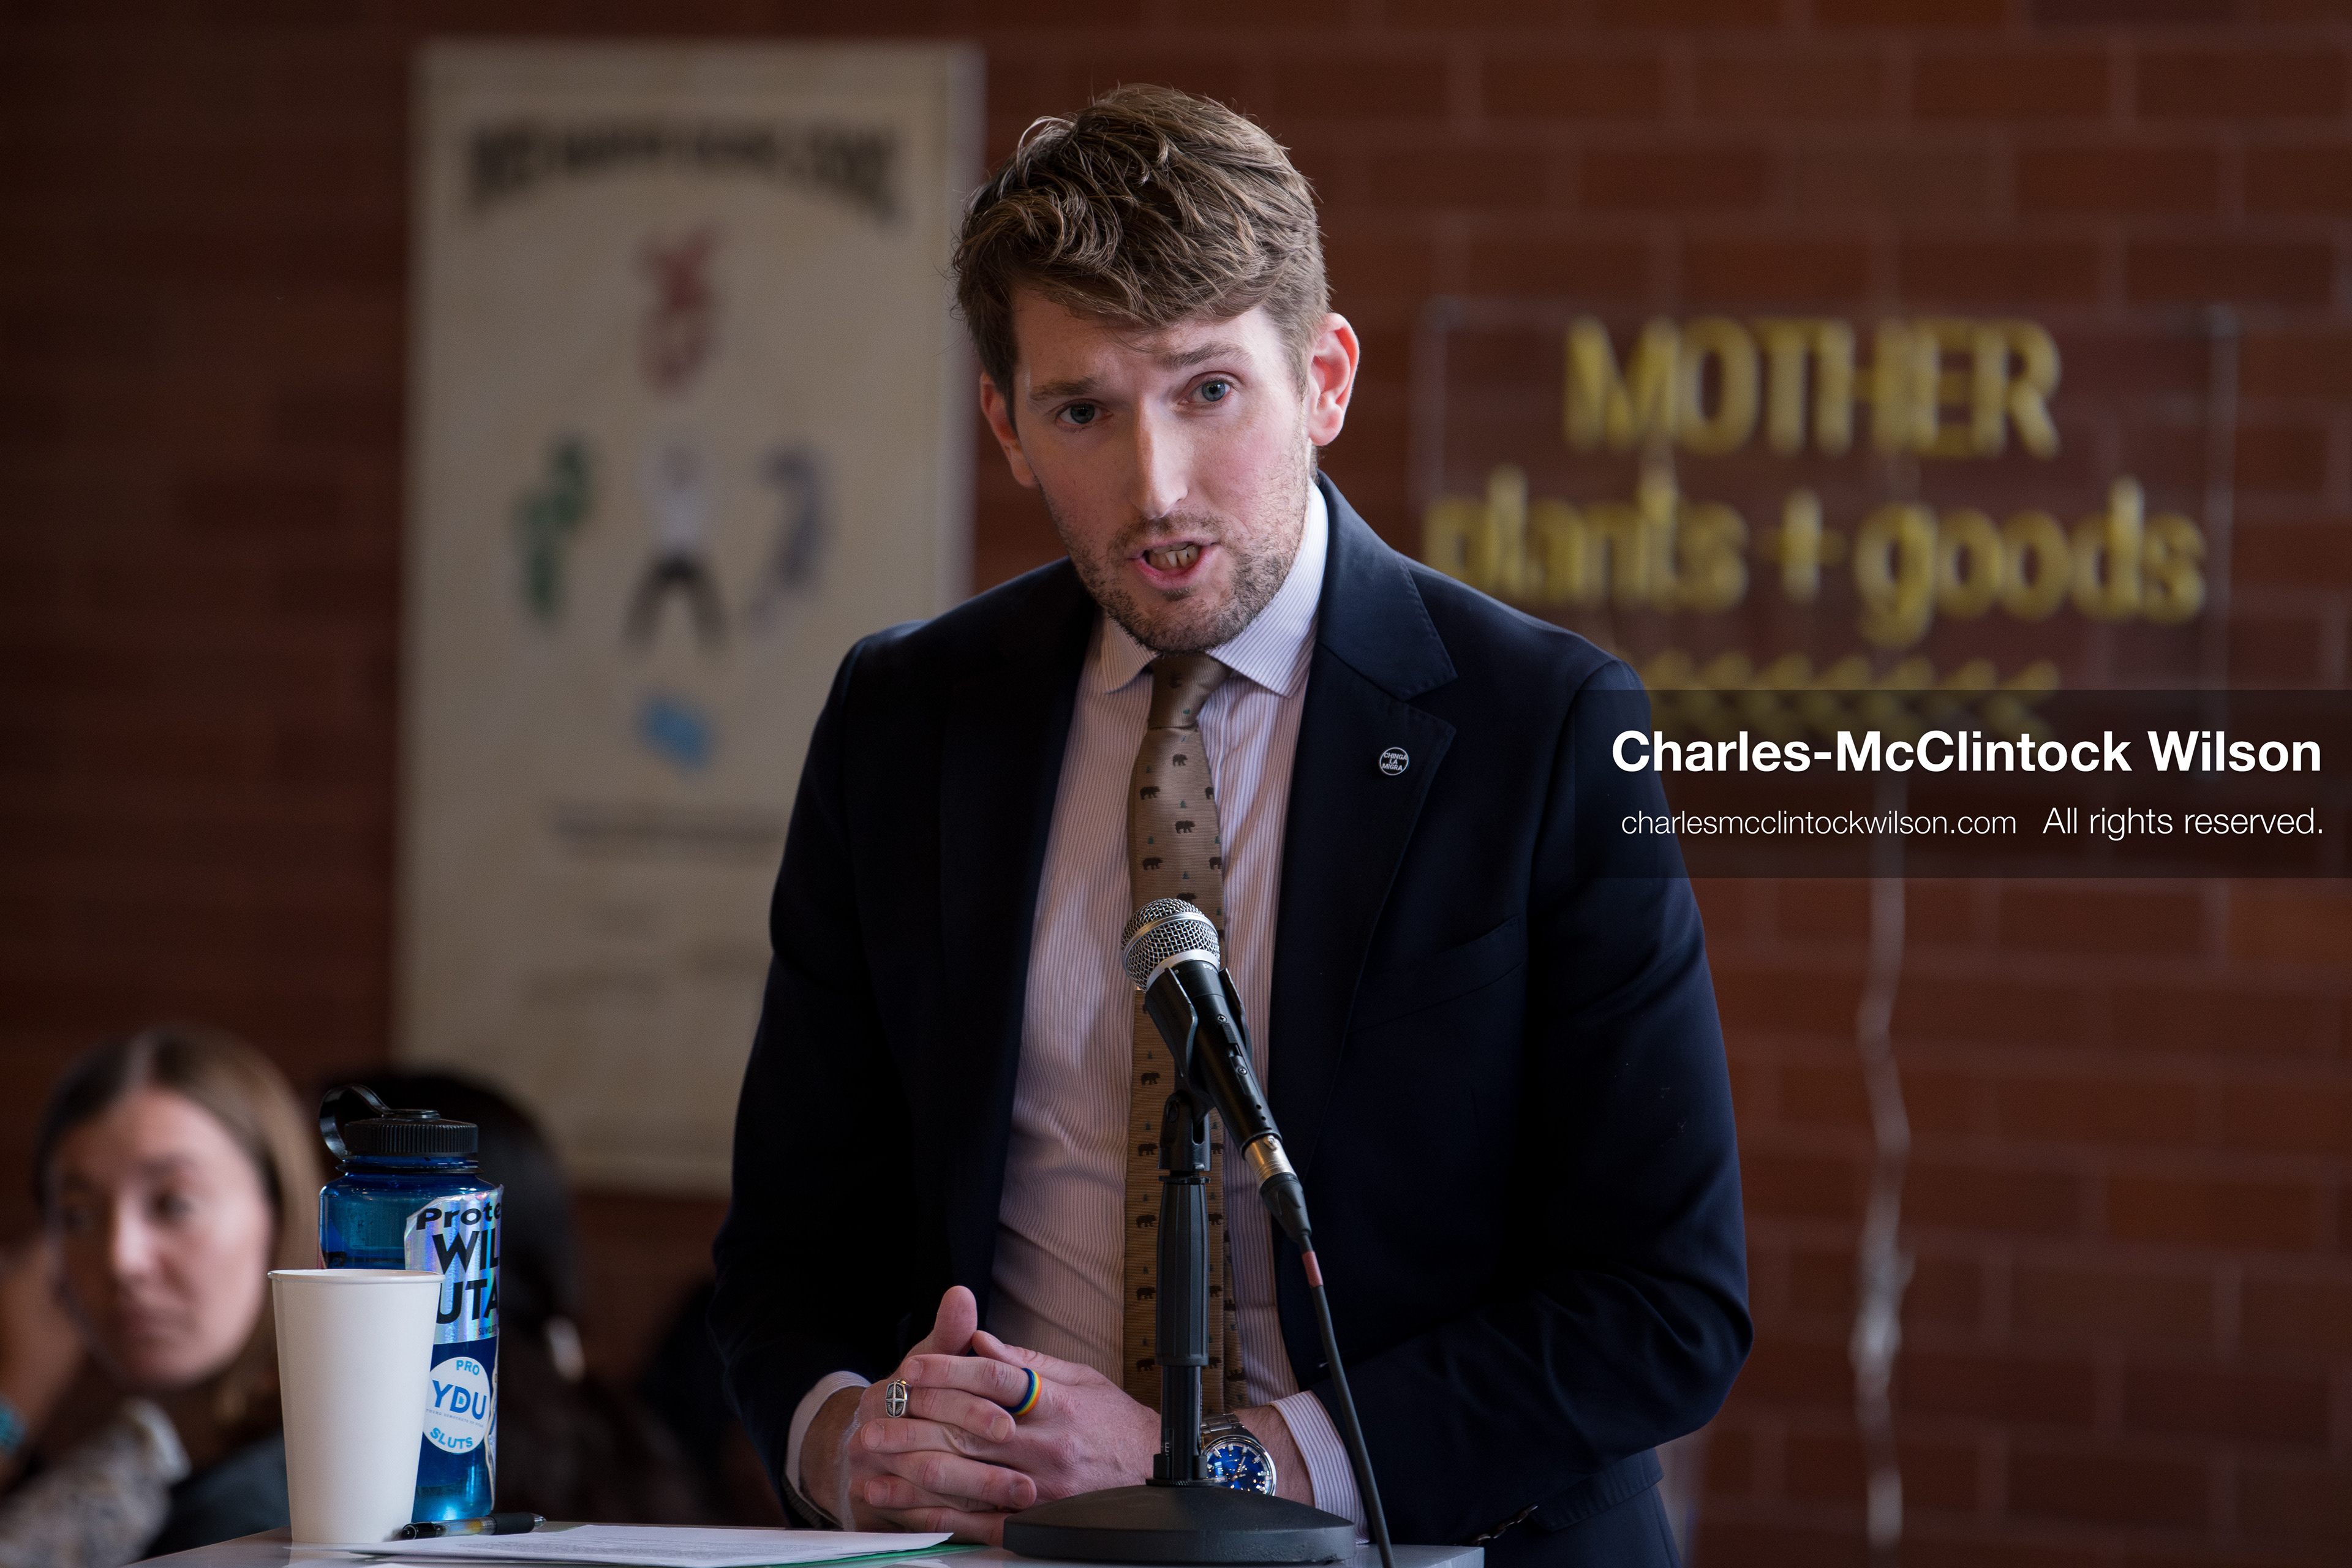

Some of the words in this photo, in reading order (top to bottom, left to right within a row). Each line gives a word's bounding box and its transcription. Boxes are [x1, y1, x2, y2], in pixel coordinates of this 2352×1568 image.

[1566, 316, 2060, 457] MOTHER
[1854, 477, 2205, 649] goods
[1382, 763, 1403, 771] MIGRA
[1384, 752, 1408, 761] CHINGA
[456, 1360, 480, 1376] PRO
[432, 1379, 487, 1420] YDU
[430, 1427, 473, 1449] SLUTS
